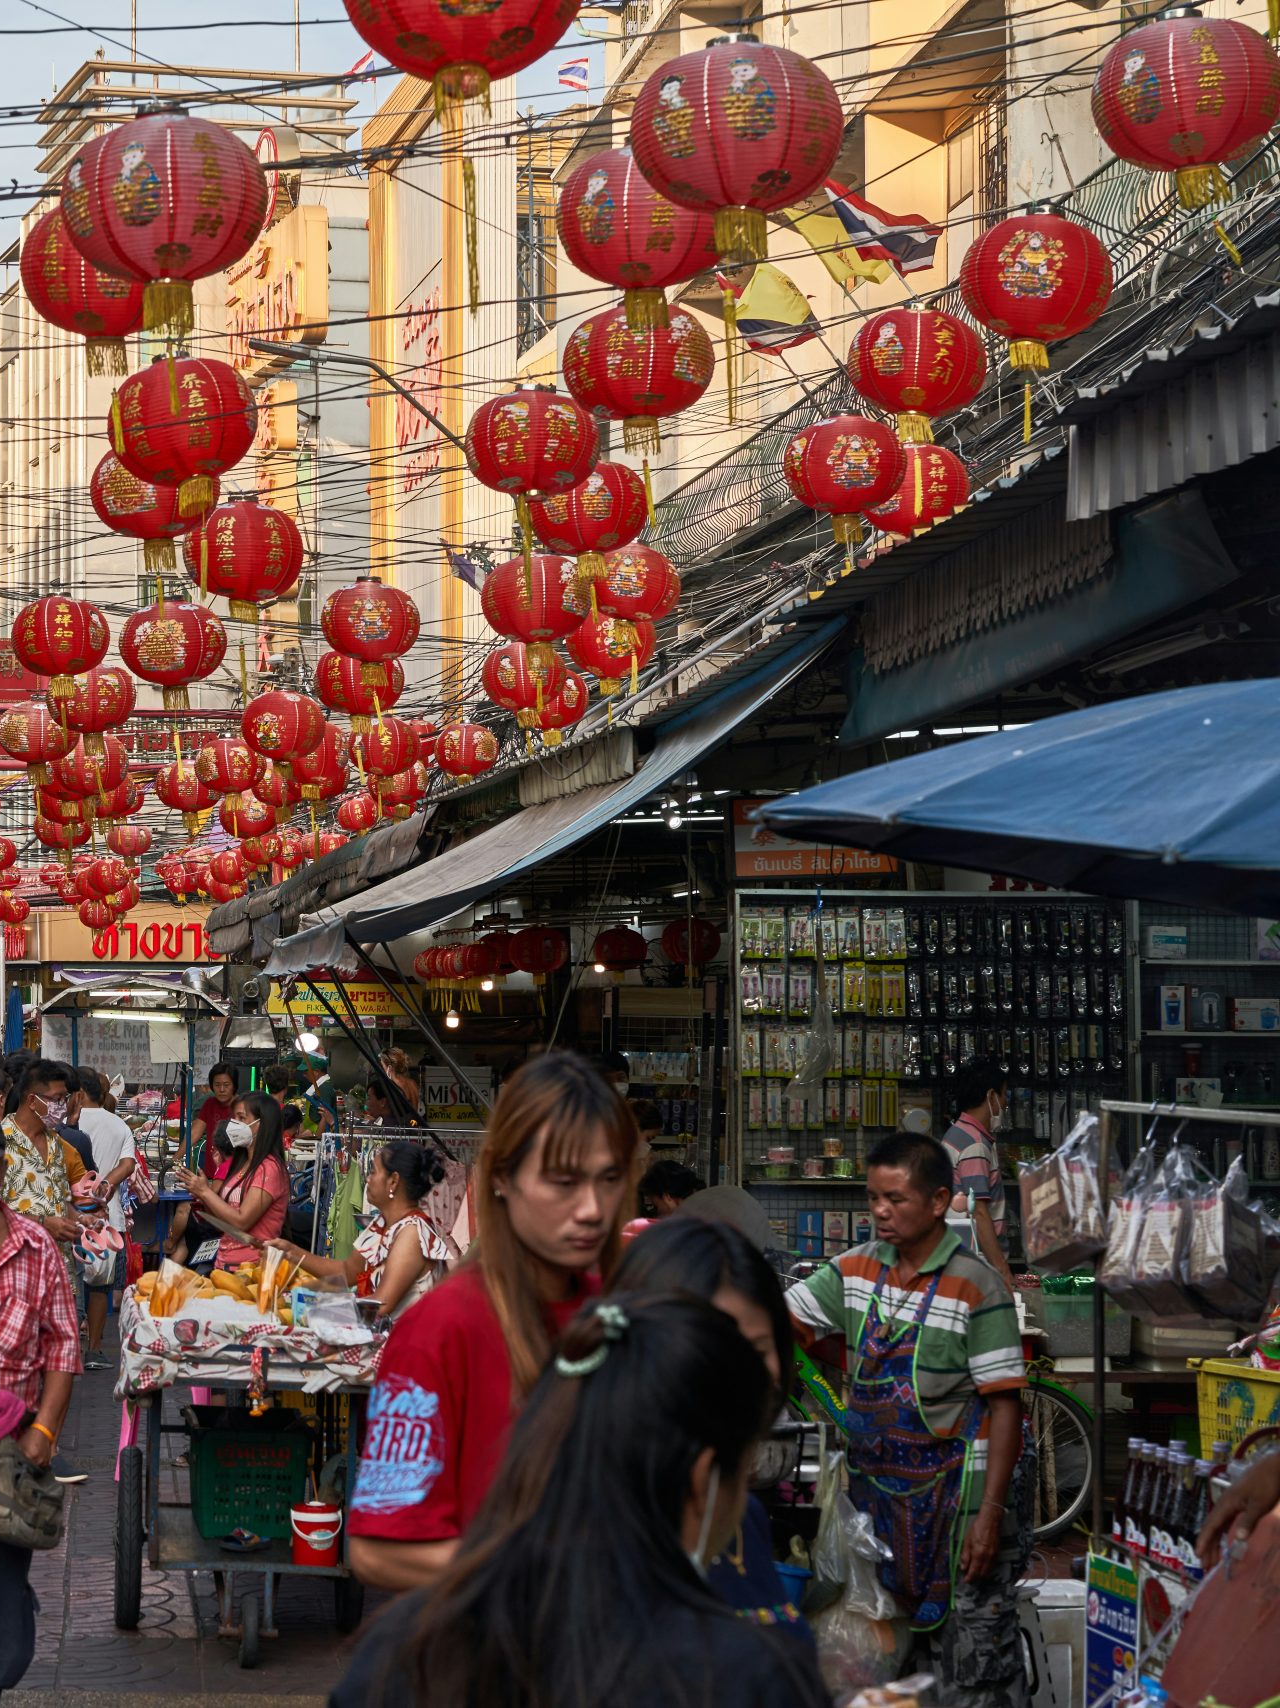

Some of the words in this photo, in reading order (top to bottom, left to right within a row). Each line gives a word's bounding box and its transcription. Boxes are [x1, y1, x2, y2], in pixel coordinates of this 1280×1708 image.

[927, 315, 956, 385] 大吉大利
[927, 453, 949, 509] 吉祥如意
[53, 602, 74, 653] 吉祥如意
